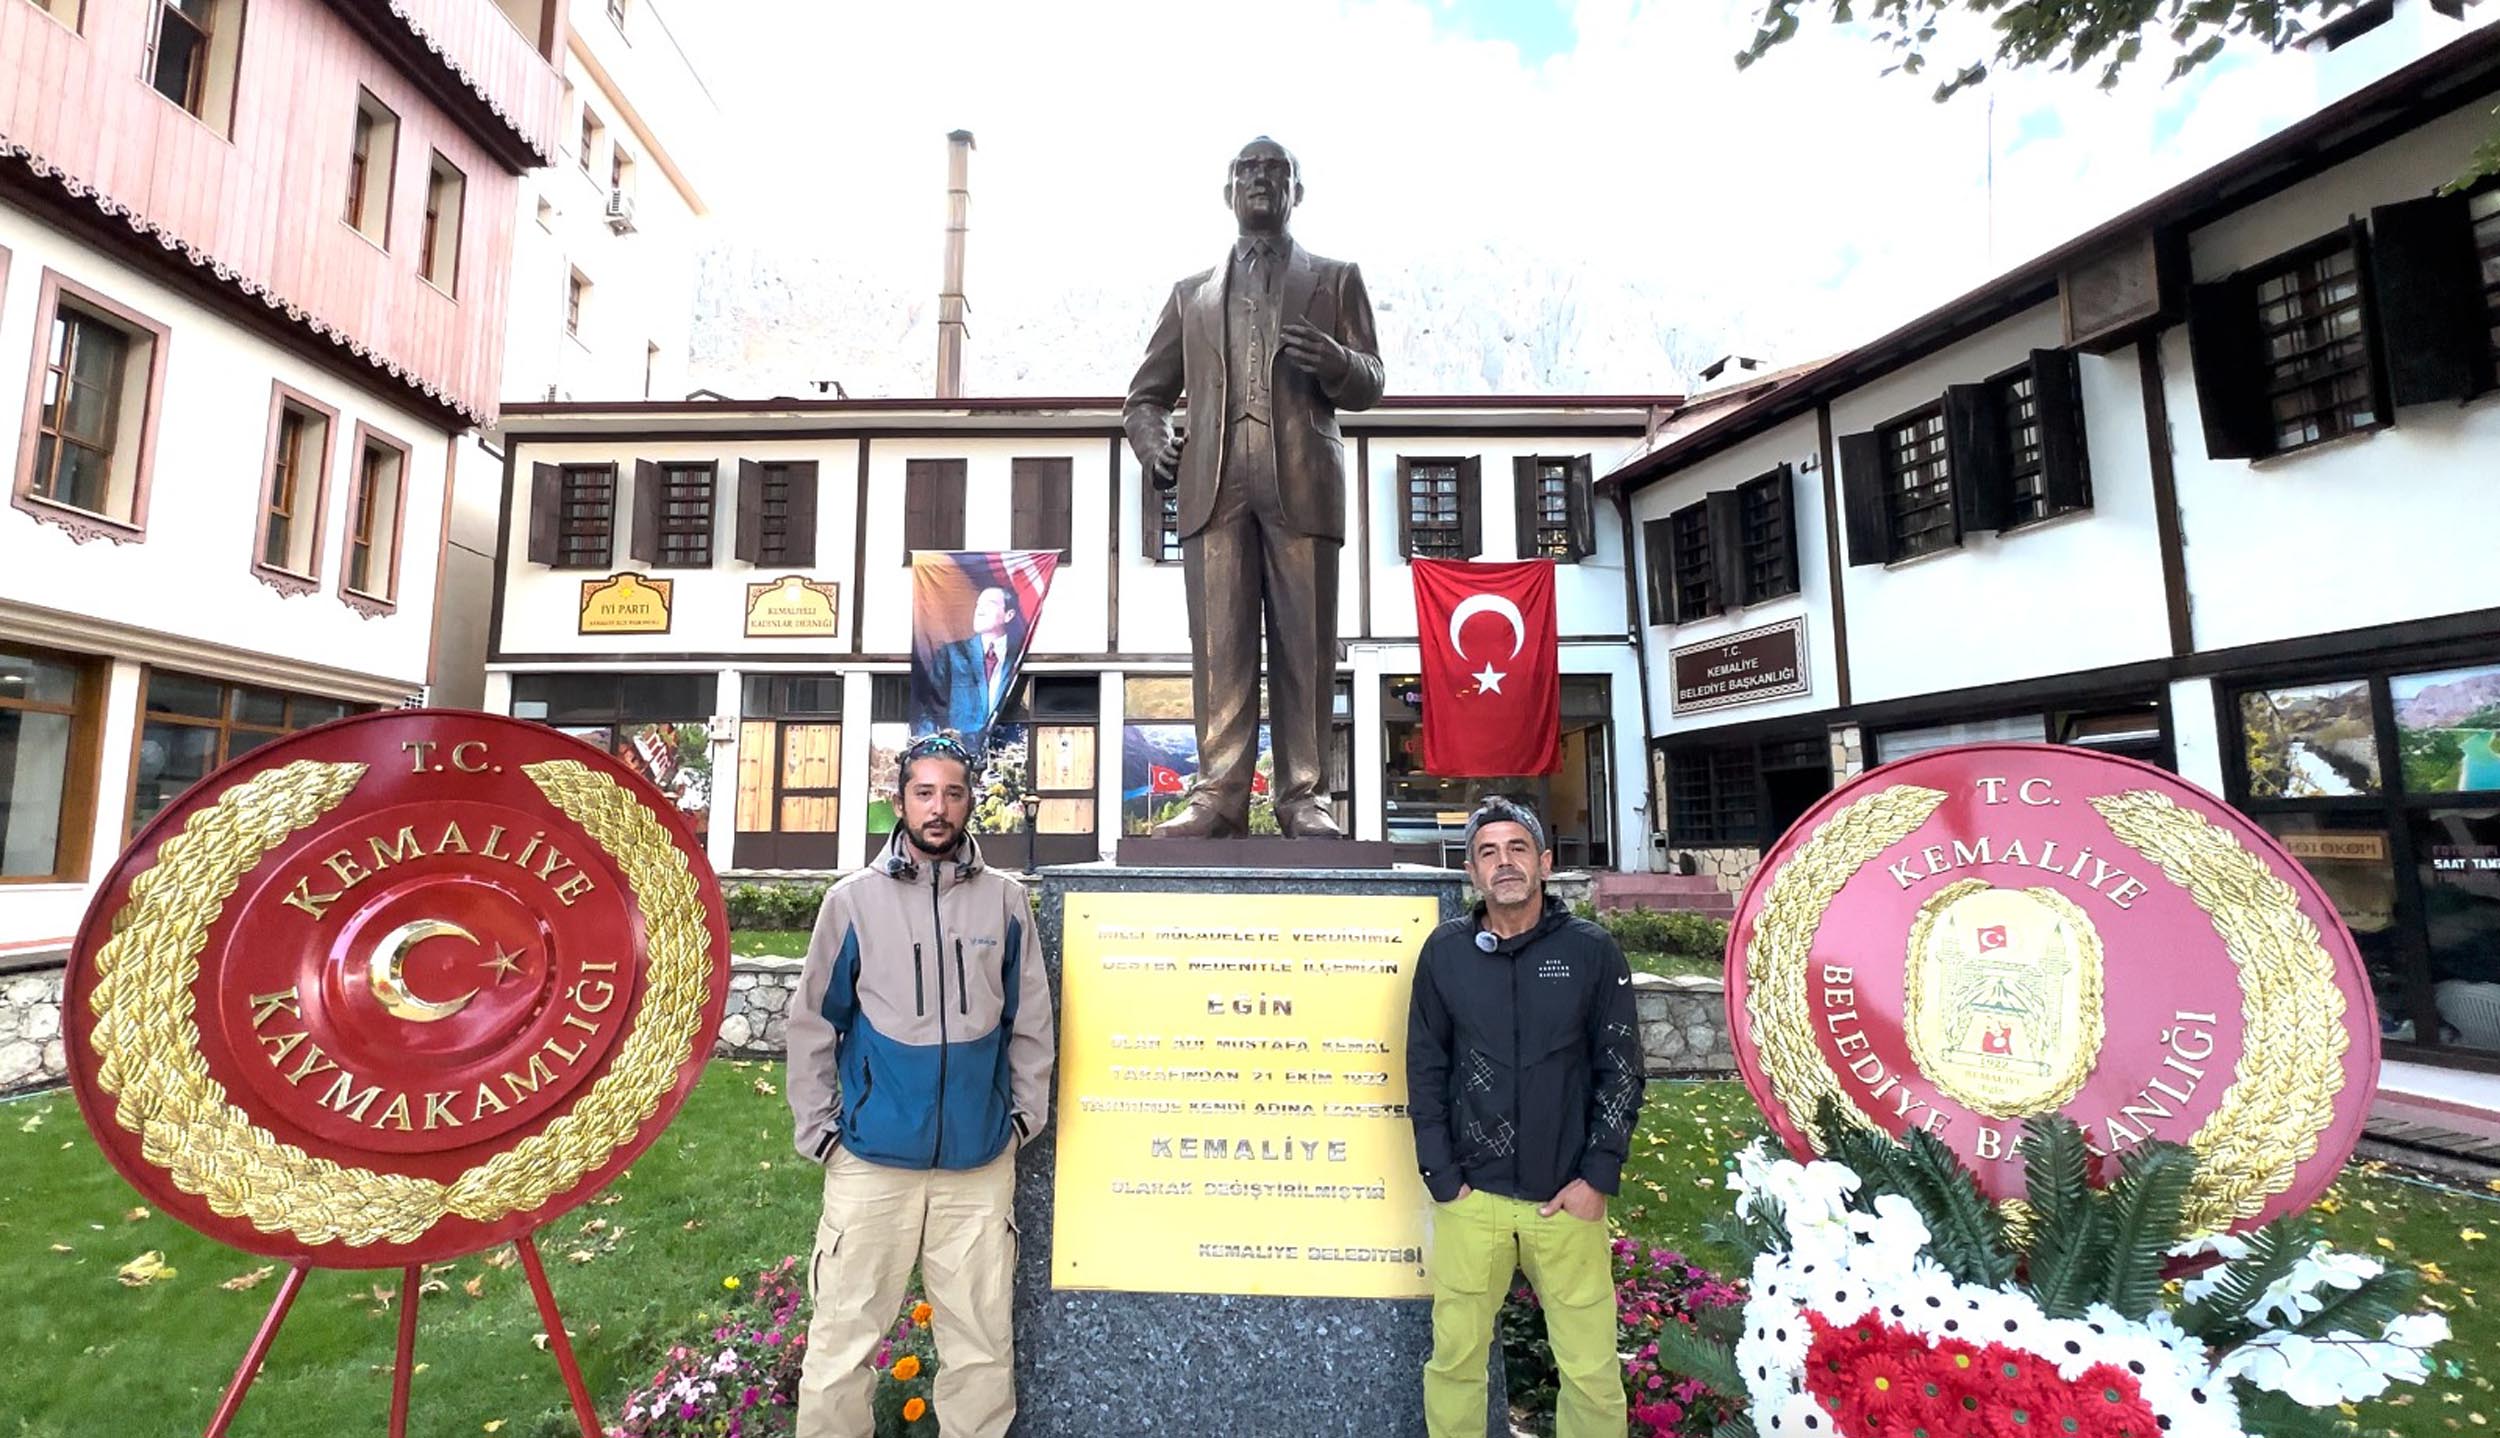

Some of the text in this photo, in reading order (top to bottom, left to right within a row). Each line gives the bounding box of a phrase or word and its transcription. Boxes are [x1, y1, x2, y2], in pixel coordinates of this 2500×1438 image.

[1706, 657, 1759, 678] KEMALİYE
[1680, 668, 1795, 700] BELEDİYE BAŞKANLIĞI
[282, 821, 596, 921] KEMALİYE
[1888, 836, 2148, 910] KEMALİYE
[2433, 858, 2467, 870] SAAT
[249, 960, 618, 1131] KAYMAKAMLIĞI
[1976, 1010, 2217, 1164] BAANLIĞI
[1323, 1103, 1410, 1118] İZAFETE
[1151, 1136, 1347, 1162] KEMALİYE
